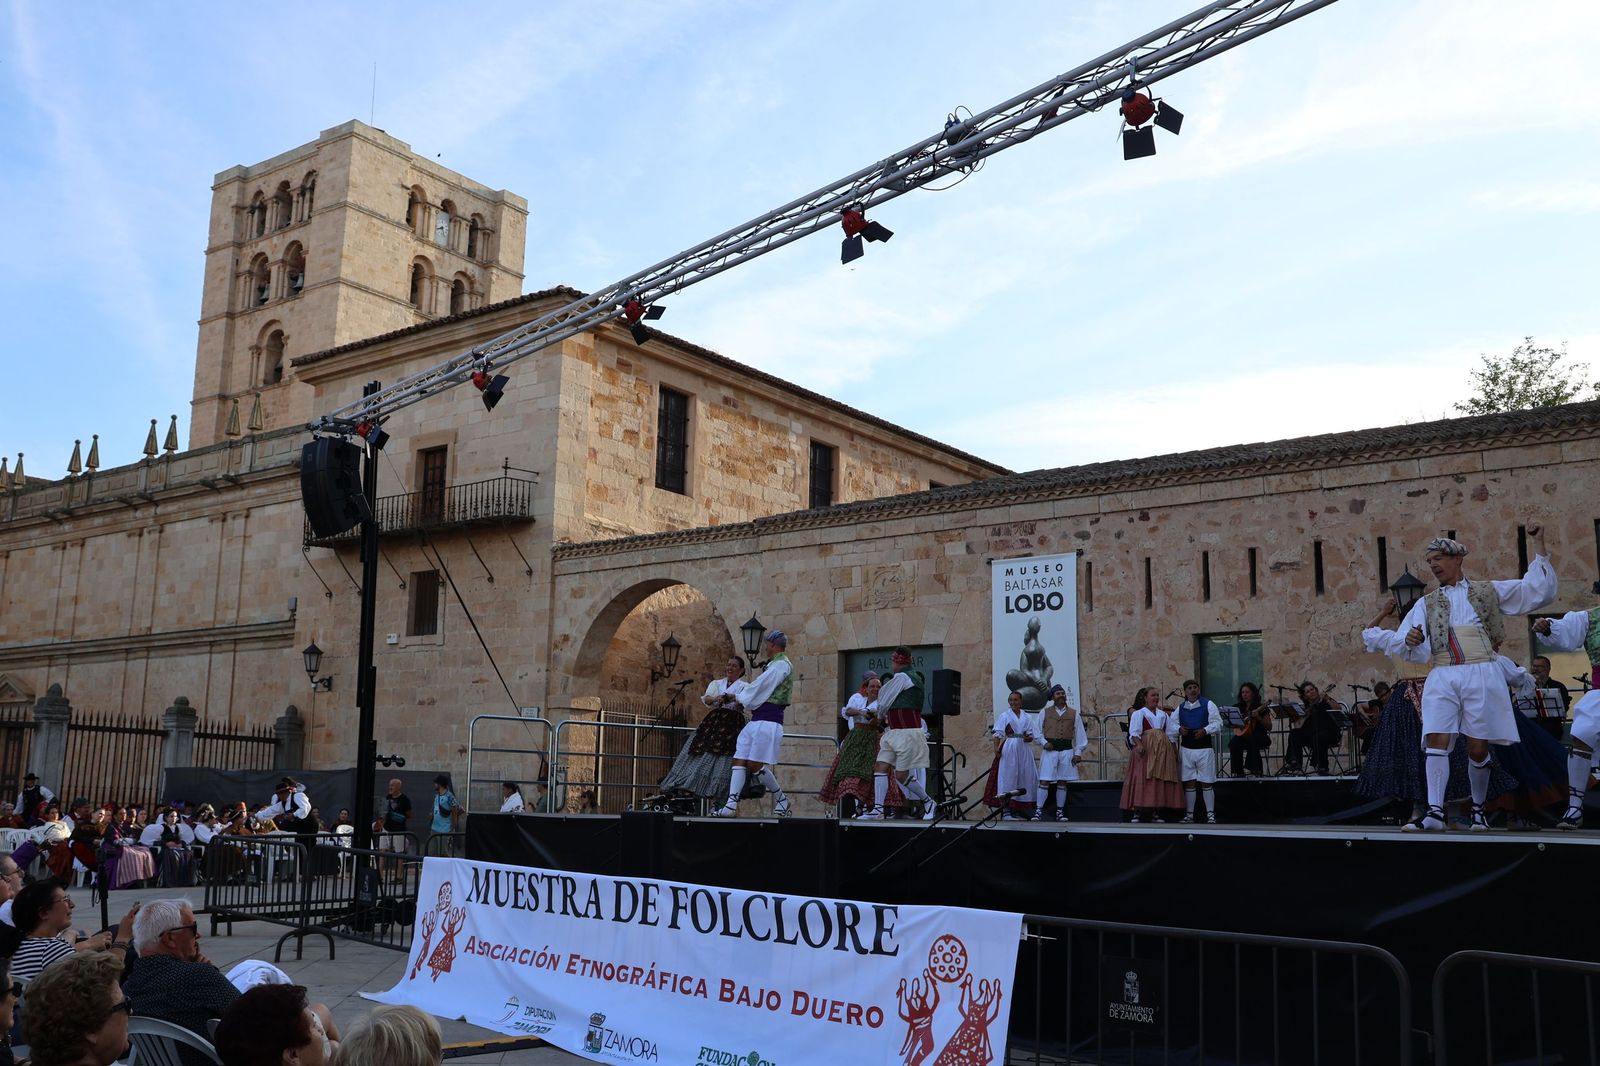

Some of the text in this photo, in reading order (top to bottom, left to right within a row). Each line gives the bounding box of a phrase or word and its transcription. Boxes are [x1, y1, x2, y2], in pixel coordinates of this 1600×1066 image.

[1005, 563, 1063, 577] MUSEO
[1004, 576, 1064, 592] BALTASAR
[1005, 591, 1064, 614] LOBO
[868, 656, 924, 670] BALAR
[466, 866, 900, 957] MUESTRA DE FOLCLORE
[565, 953, 708, 999] ETNOGRÁFICA
[718, 978, 782, 1011] BAJO
[790, 990, 884, 1029] DUERO
[1109, 1002, 1154, 1015] AYUNTAMIENTO
[1109, 1008, 1154, 1024] DE ZAMORA
[603, 1028, 658, 1063] ZAMORA
